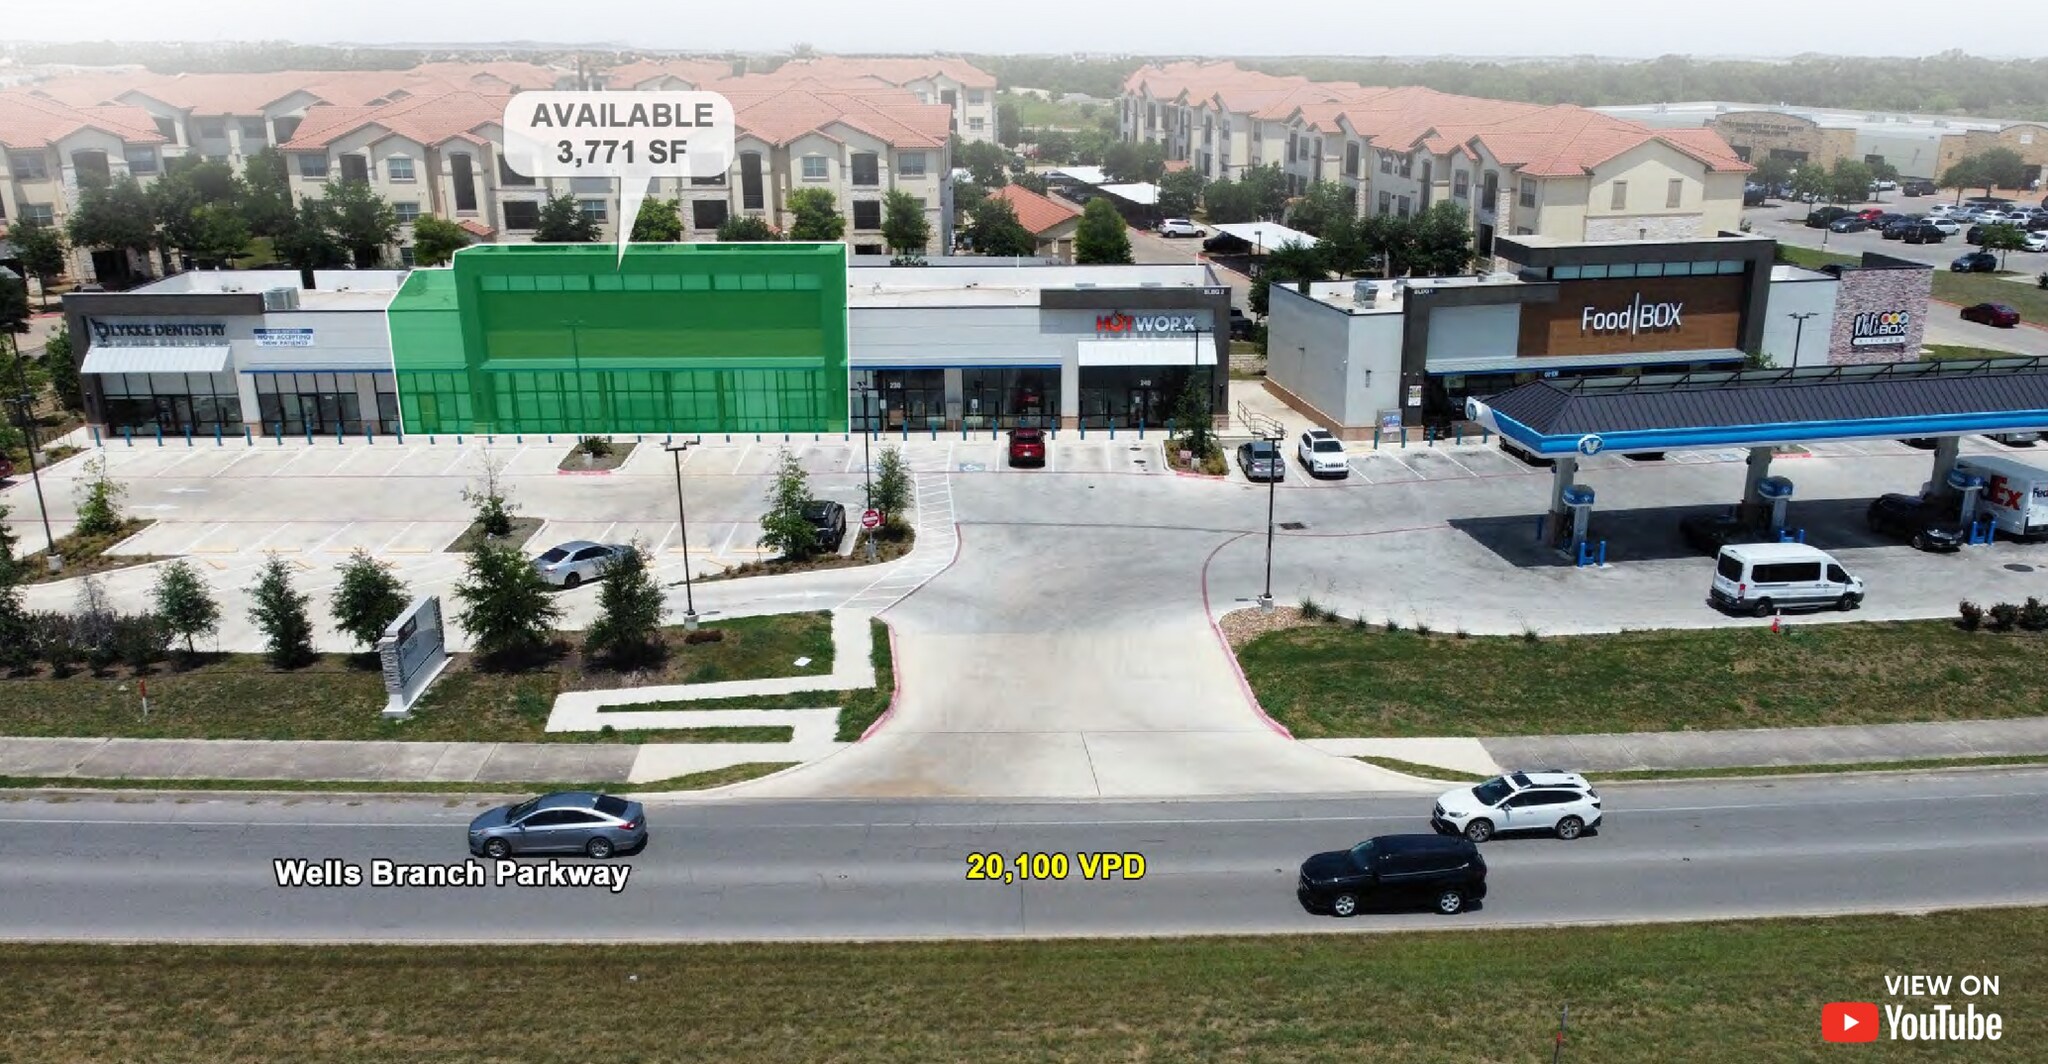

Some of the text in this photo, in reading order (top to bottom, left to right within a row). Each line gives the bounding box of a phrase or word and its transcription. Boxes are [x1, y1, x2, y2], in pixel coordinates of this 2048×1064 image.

[110, 323, 226, 337] LYKKE DENTISTRY
[1879, 324, 1907, 335] BOX
